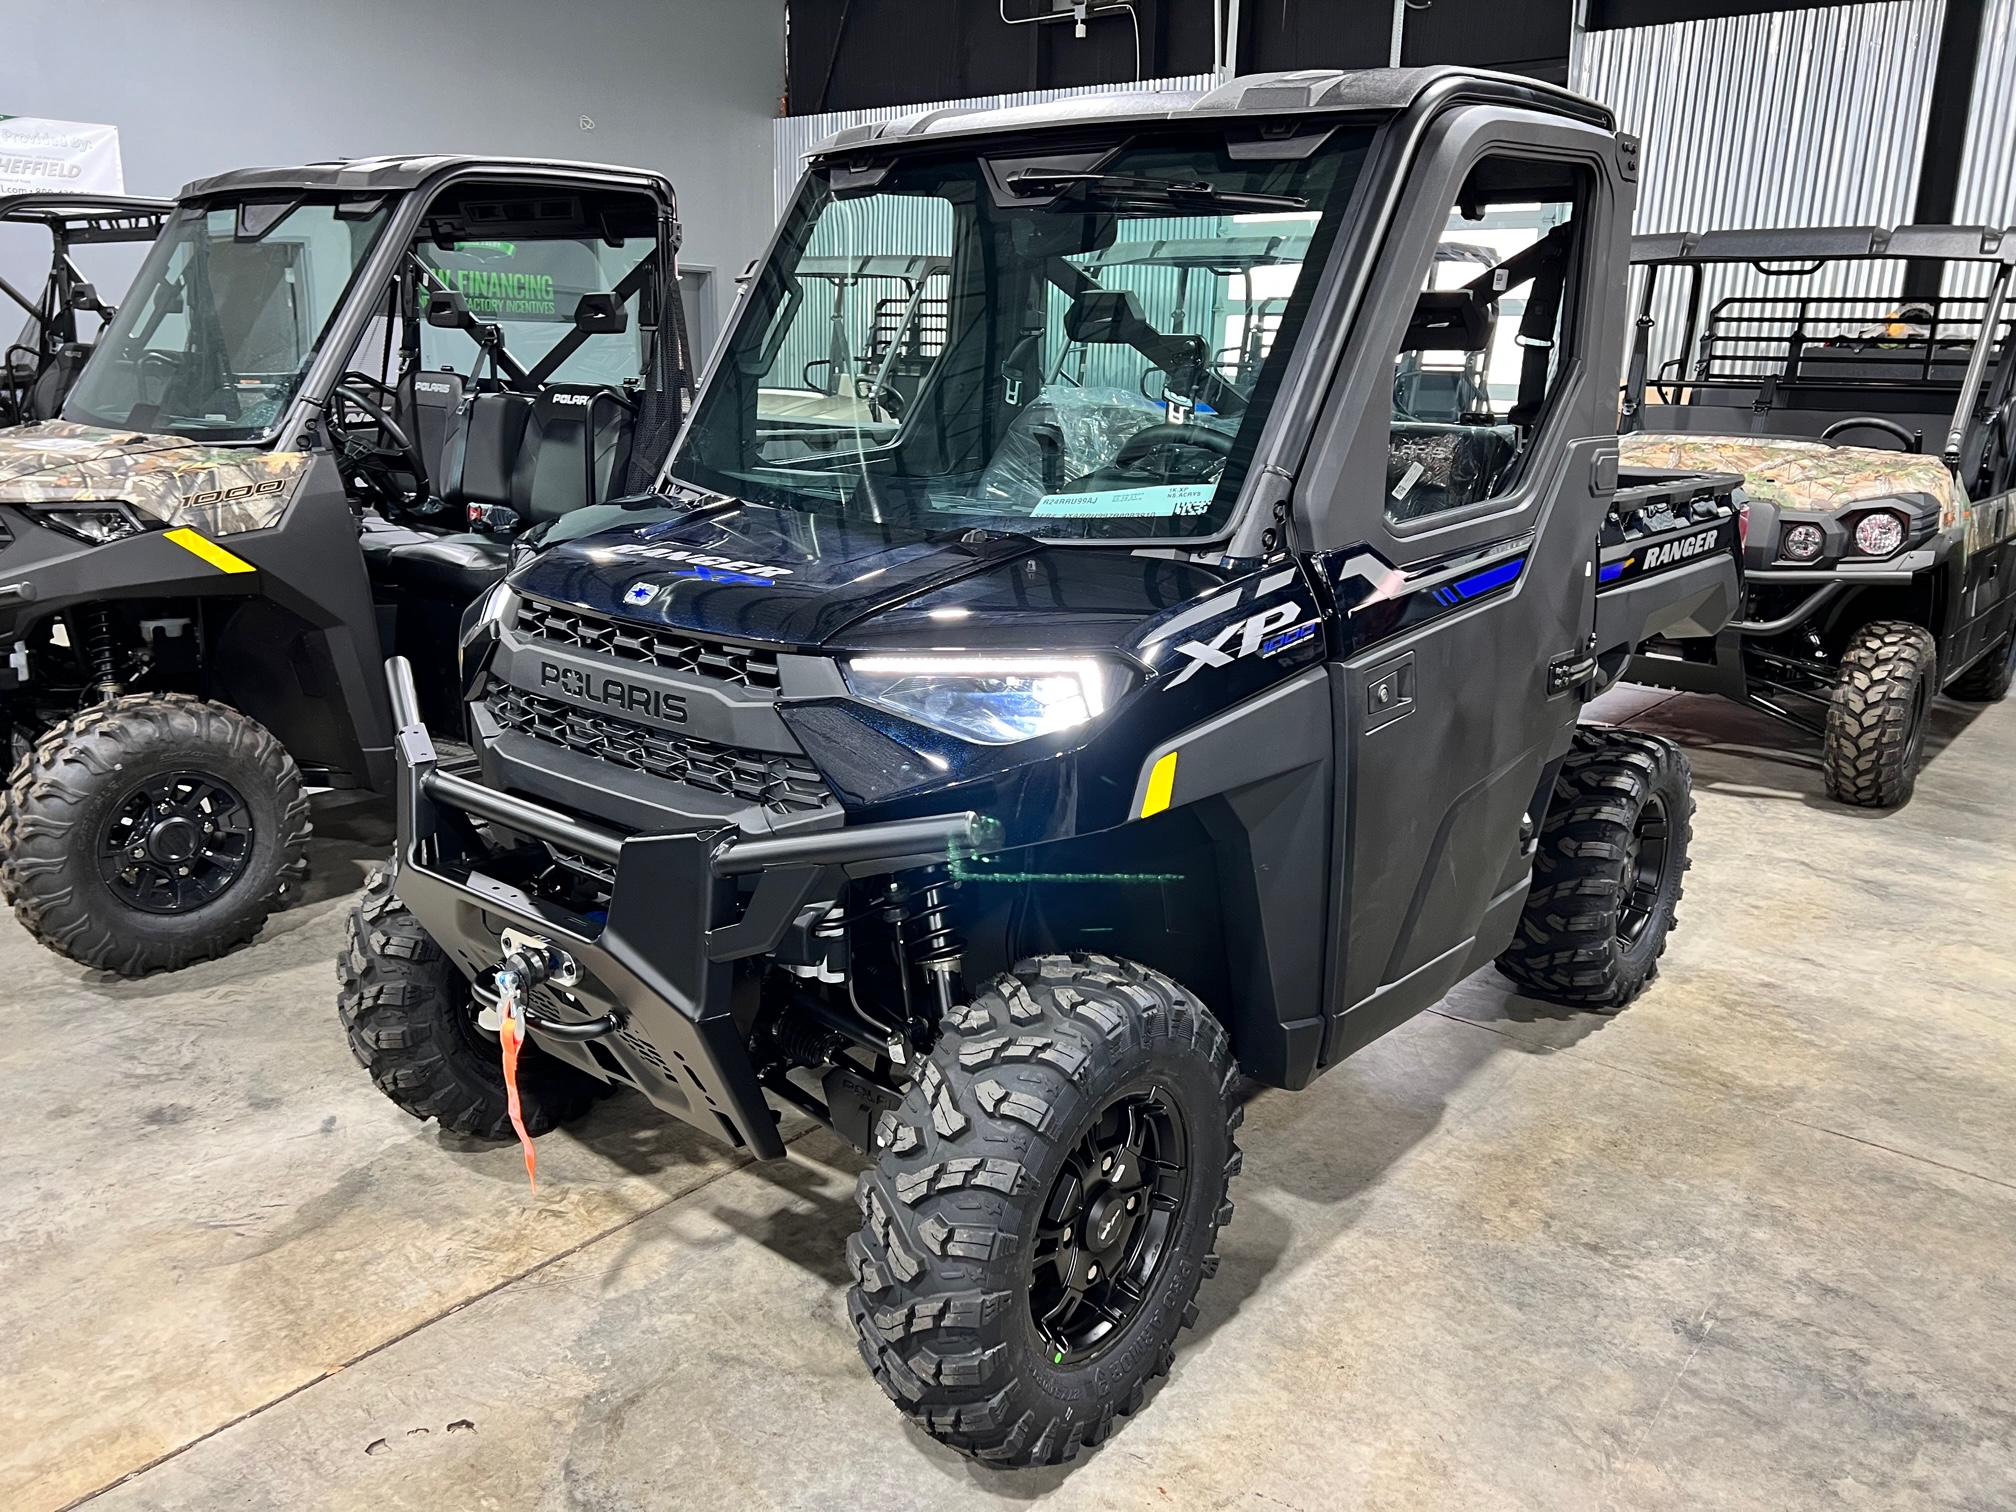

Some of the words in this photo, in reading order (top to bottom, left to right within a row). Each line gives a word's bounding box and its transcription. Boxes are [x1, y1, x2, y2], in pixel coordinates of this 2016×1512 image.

[457, 269, 555, 300] FINANCING
[506, 301, 556, 315] INCENTIVES
[414, 381, 451, 394] POLARIS
[180, 479, 287, 509] 1000
[607, 543, 795, 579] RANGER
[1641, 529, 1719, 571] RANGER
[1162, 600, 1302, 692] XP
[1262, 621, 1316, 654] 1000
[540, 660, 689, 725] POLARIS
